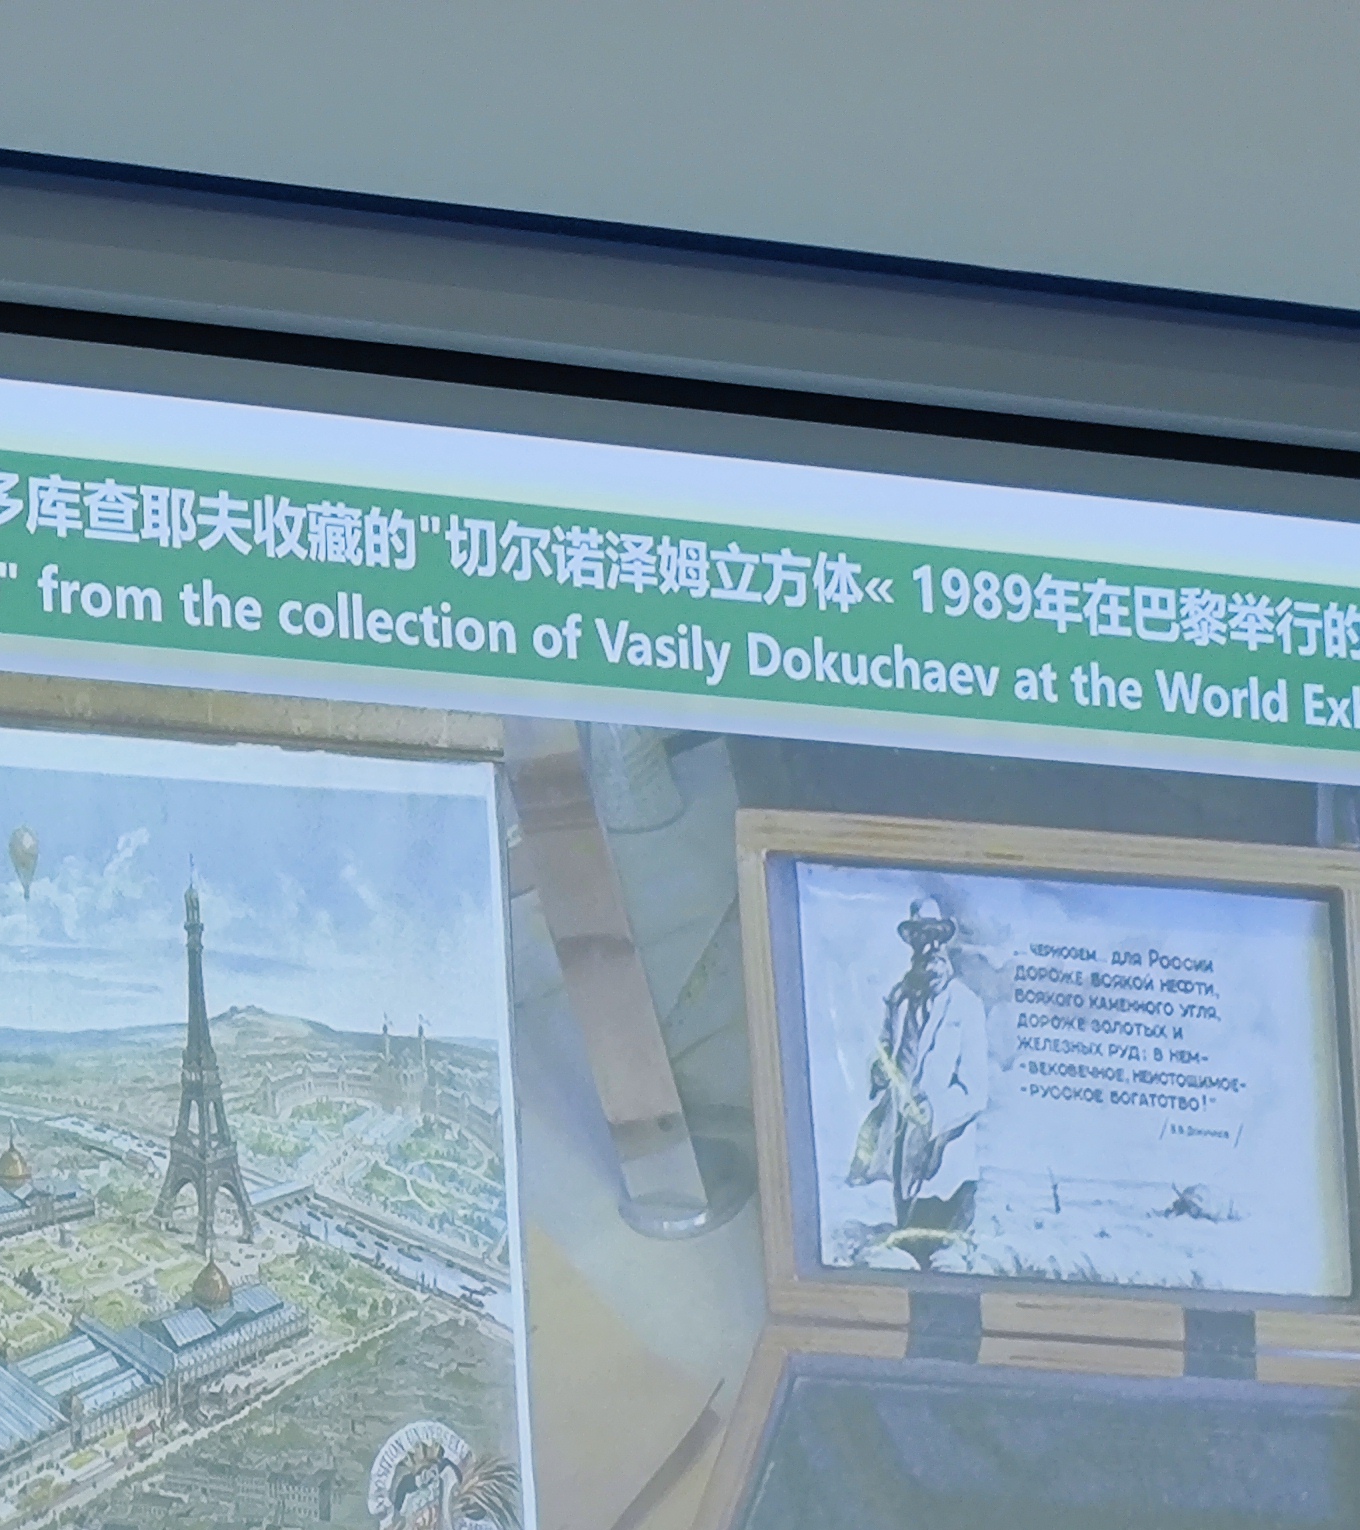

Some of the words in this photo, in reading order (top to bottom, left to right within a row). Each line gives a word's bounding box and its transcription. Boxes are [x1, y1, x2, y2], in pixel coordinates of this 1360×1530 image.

[37, 571, 163, 624] from
[180, 581, 263, 632] the
[278, 589, 517, 655] collection
[538, 613, 584, 661] of
[595, 620, 731, 686] Vasily
[748, 637, 1000, 699] Dokuchaev
[1013, 668, 1058, 704] at
[1069, 664, 1143, 711] the
[1155, 669, 1289, 724] World
